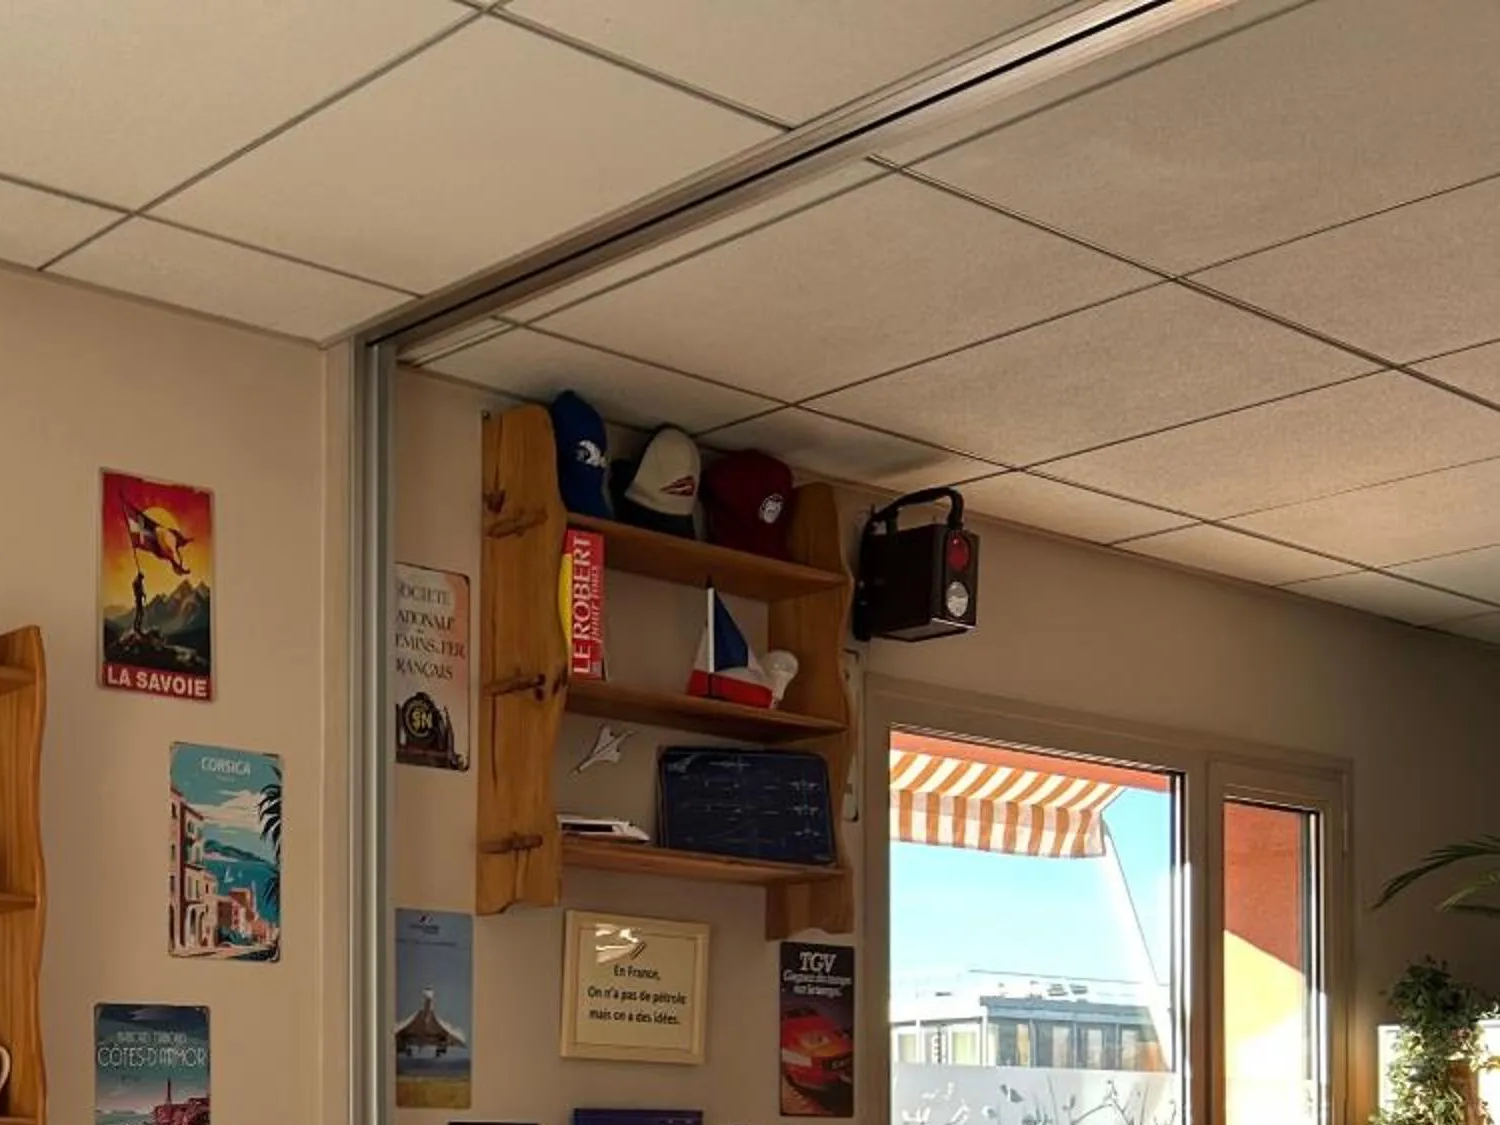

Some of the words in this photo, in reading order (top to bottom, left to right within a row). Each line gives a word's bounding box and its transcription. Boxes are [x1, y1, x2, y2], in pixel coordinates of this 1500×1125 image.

[573, 536, 592, 640] ROBERT
[573, 645, 591, 673] LE
[107, 665, 132, 687] LA
[136, 671, 208, 697] SAVOIE
[800, 951, 837, 973] TGV
